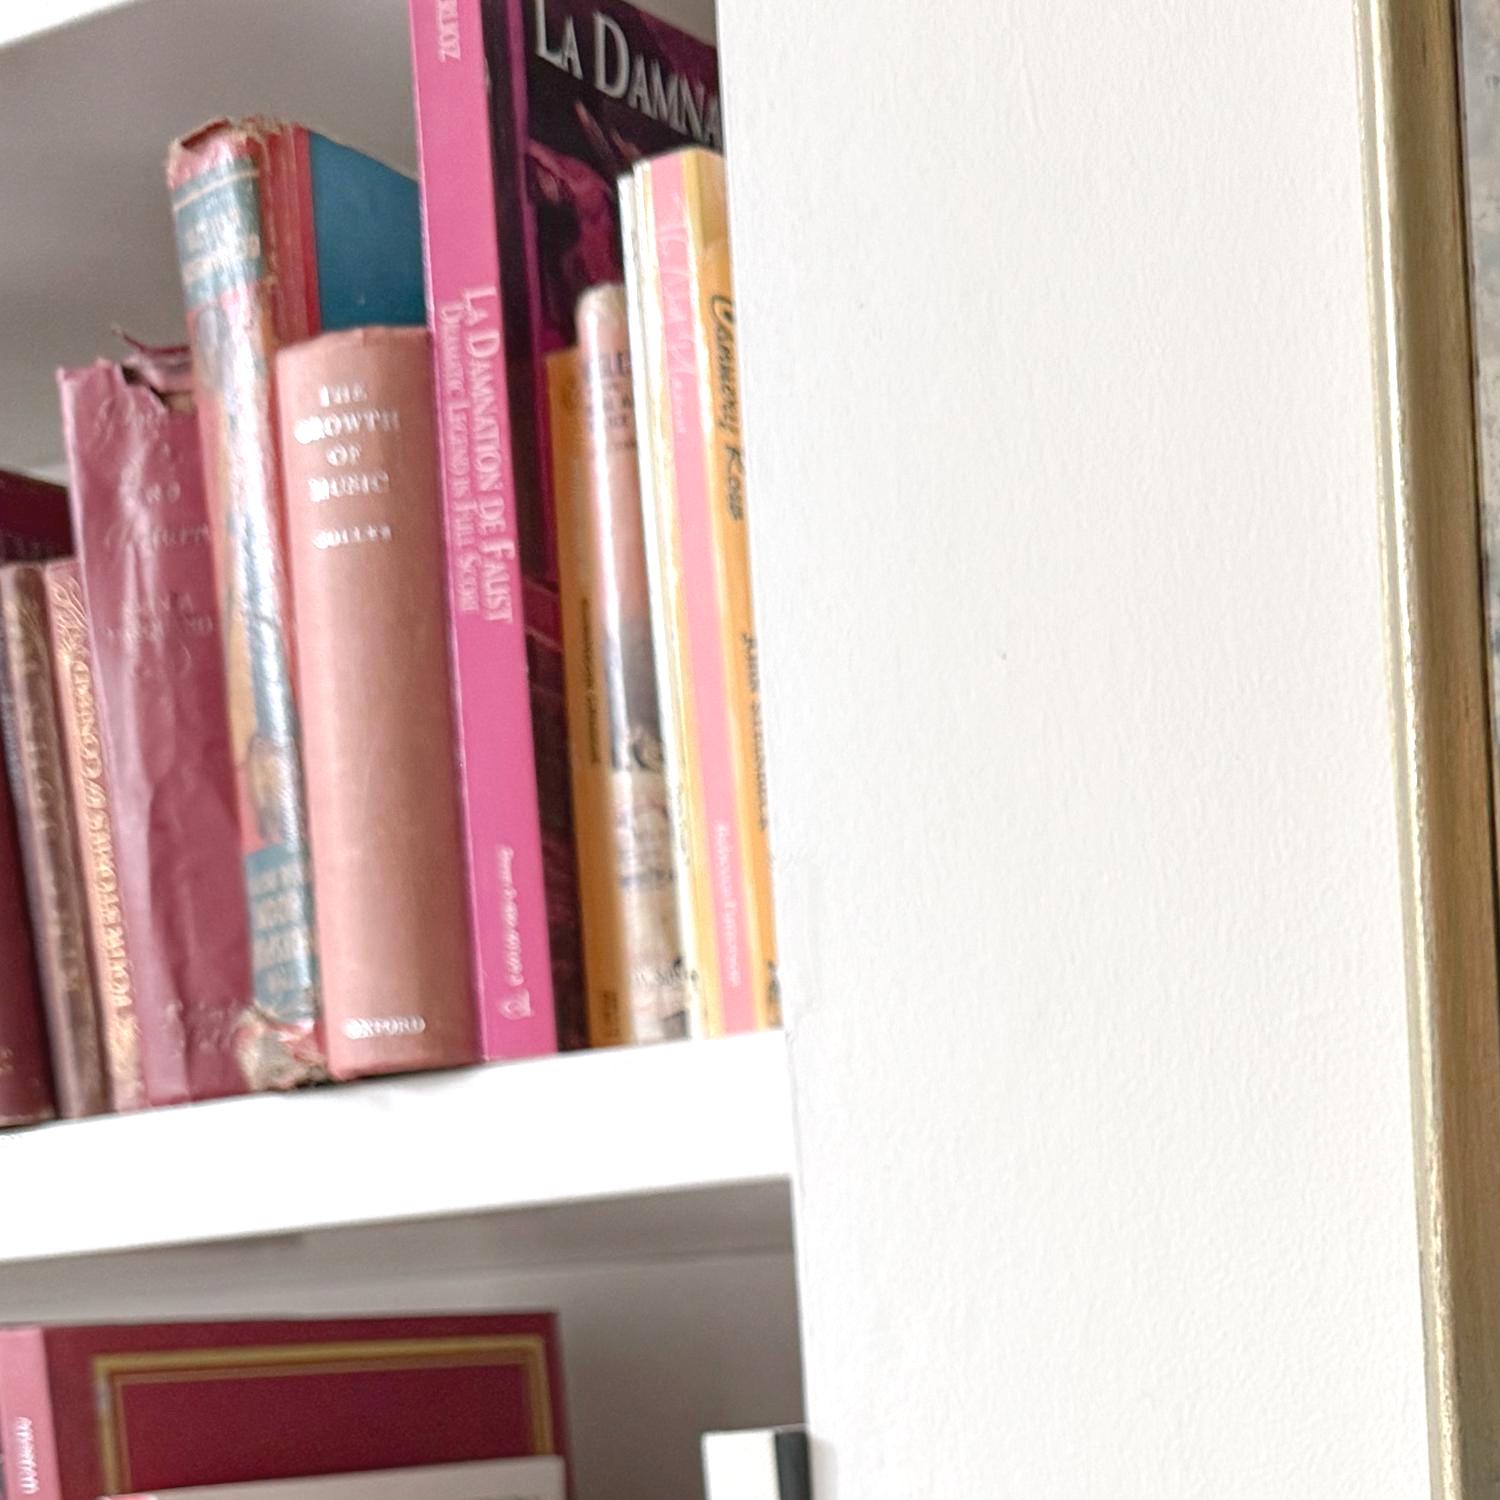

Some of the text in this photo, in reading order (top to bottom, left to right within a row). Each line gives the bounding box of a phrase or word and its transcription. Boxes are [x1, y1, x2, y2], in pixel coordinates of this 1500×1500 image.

[535, 0, 584, 80] LA
[294, 409, 399, 445] GROWTH
[463, 286, 516, 624] LA DAMNATION DE FAUST
[308, 469, 391, 502] MUSIC
[345, 1013, 427, 1040] OXFORD
